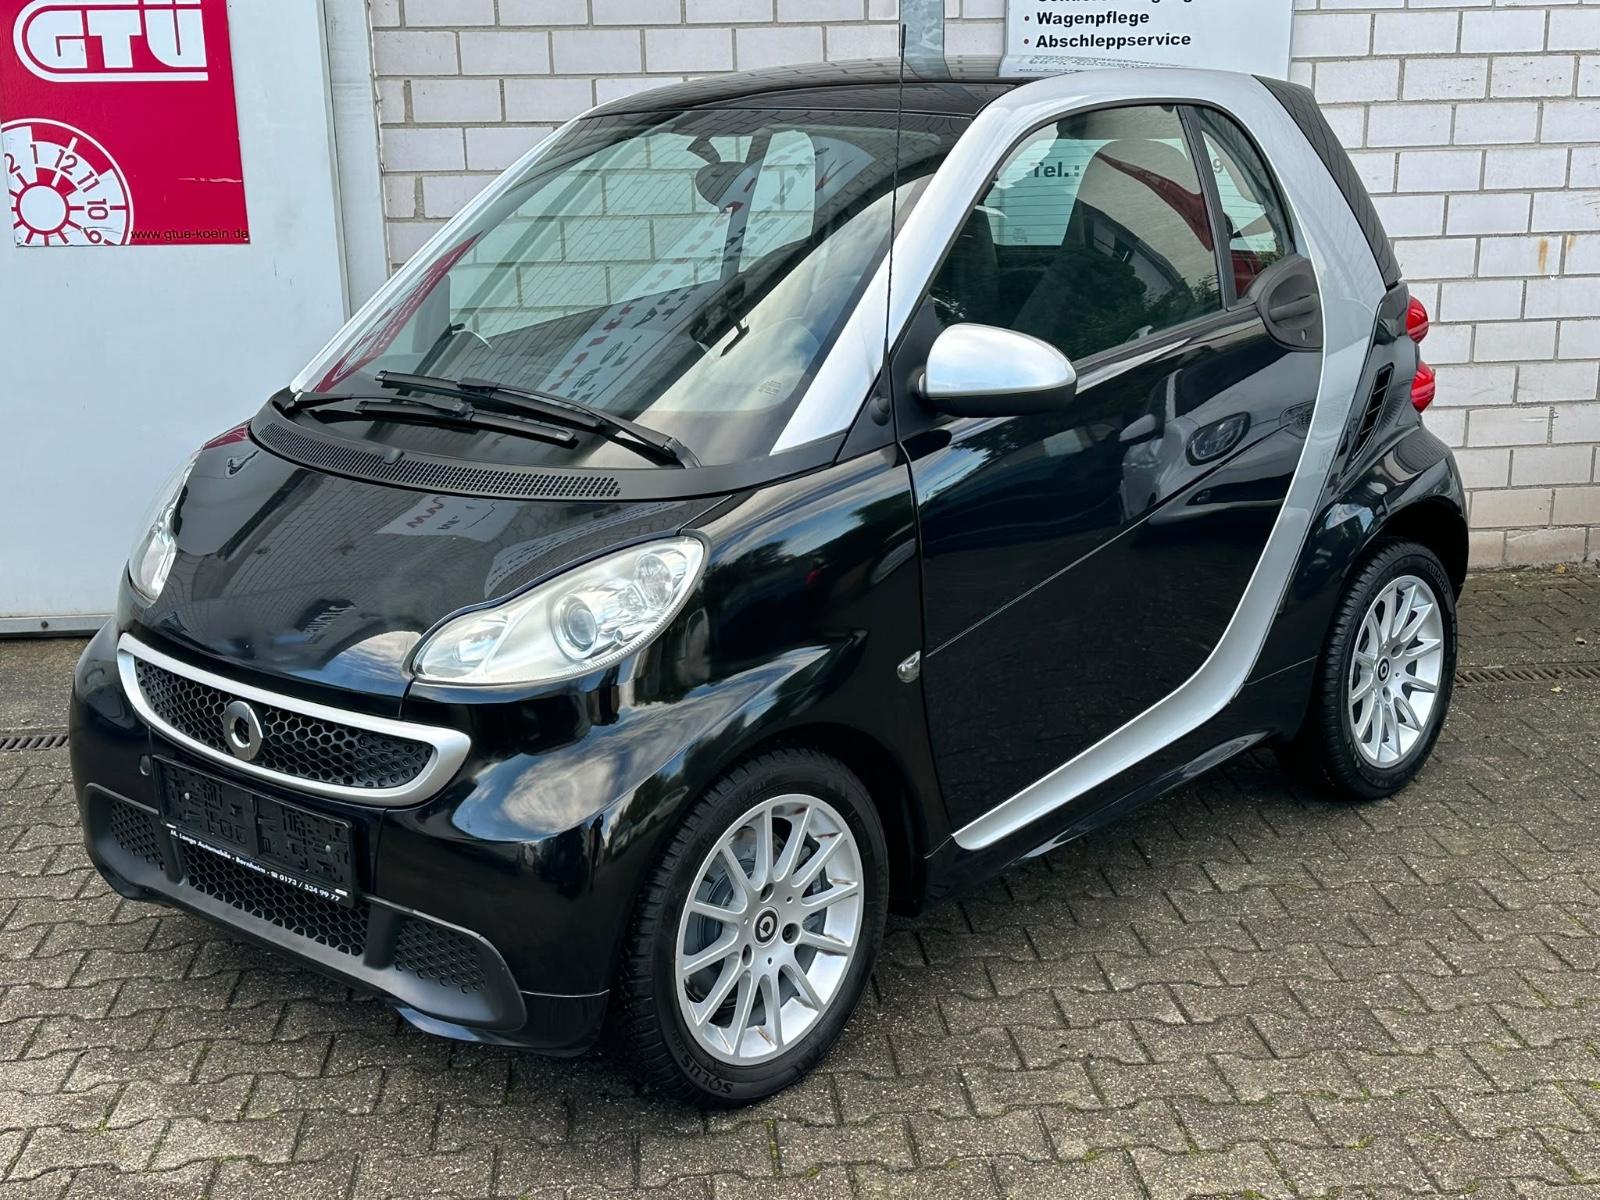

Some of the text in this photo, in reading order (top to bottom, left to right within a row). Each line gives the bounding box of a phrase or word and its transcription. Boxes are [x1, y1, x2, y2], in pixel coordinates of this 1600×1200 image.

[1037, 11, 1150, 28] Wagenpflege
[1036, 33, 1192, 50] Abschleppservice
[4, 153, 21, 174] 2
[30, 144, 39, 164] 1
[55, 148, 78, 176] 12
[77, 170, 100, 192] 11
[87, 198, 109, 220] 10
[680, 1054, 734, 1095] SOLUS
